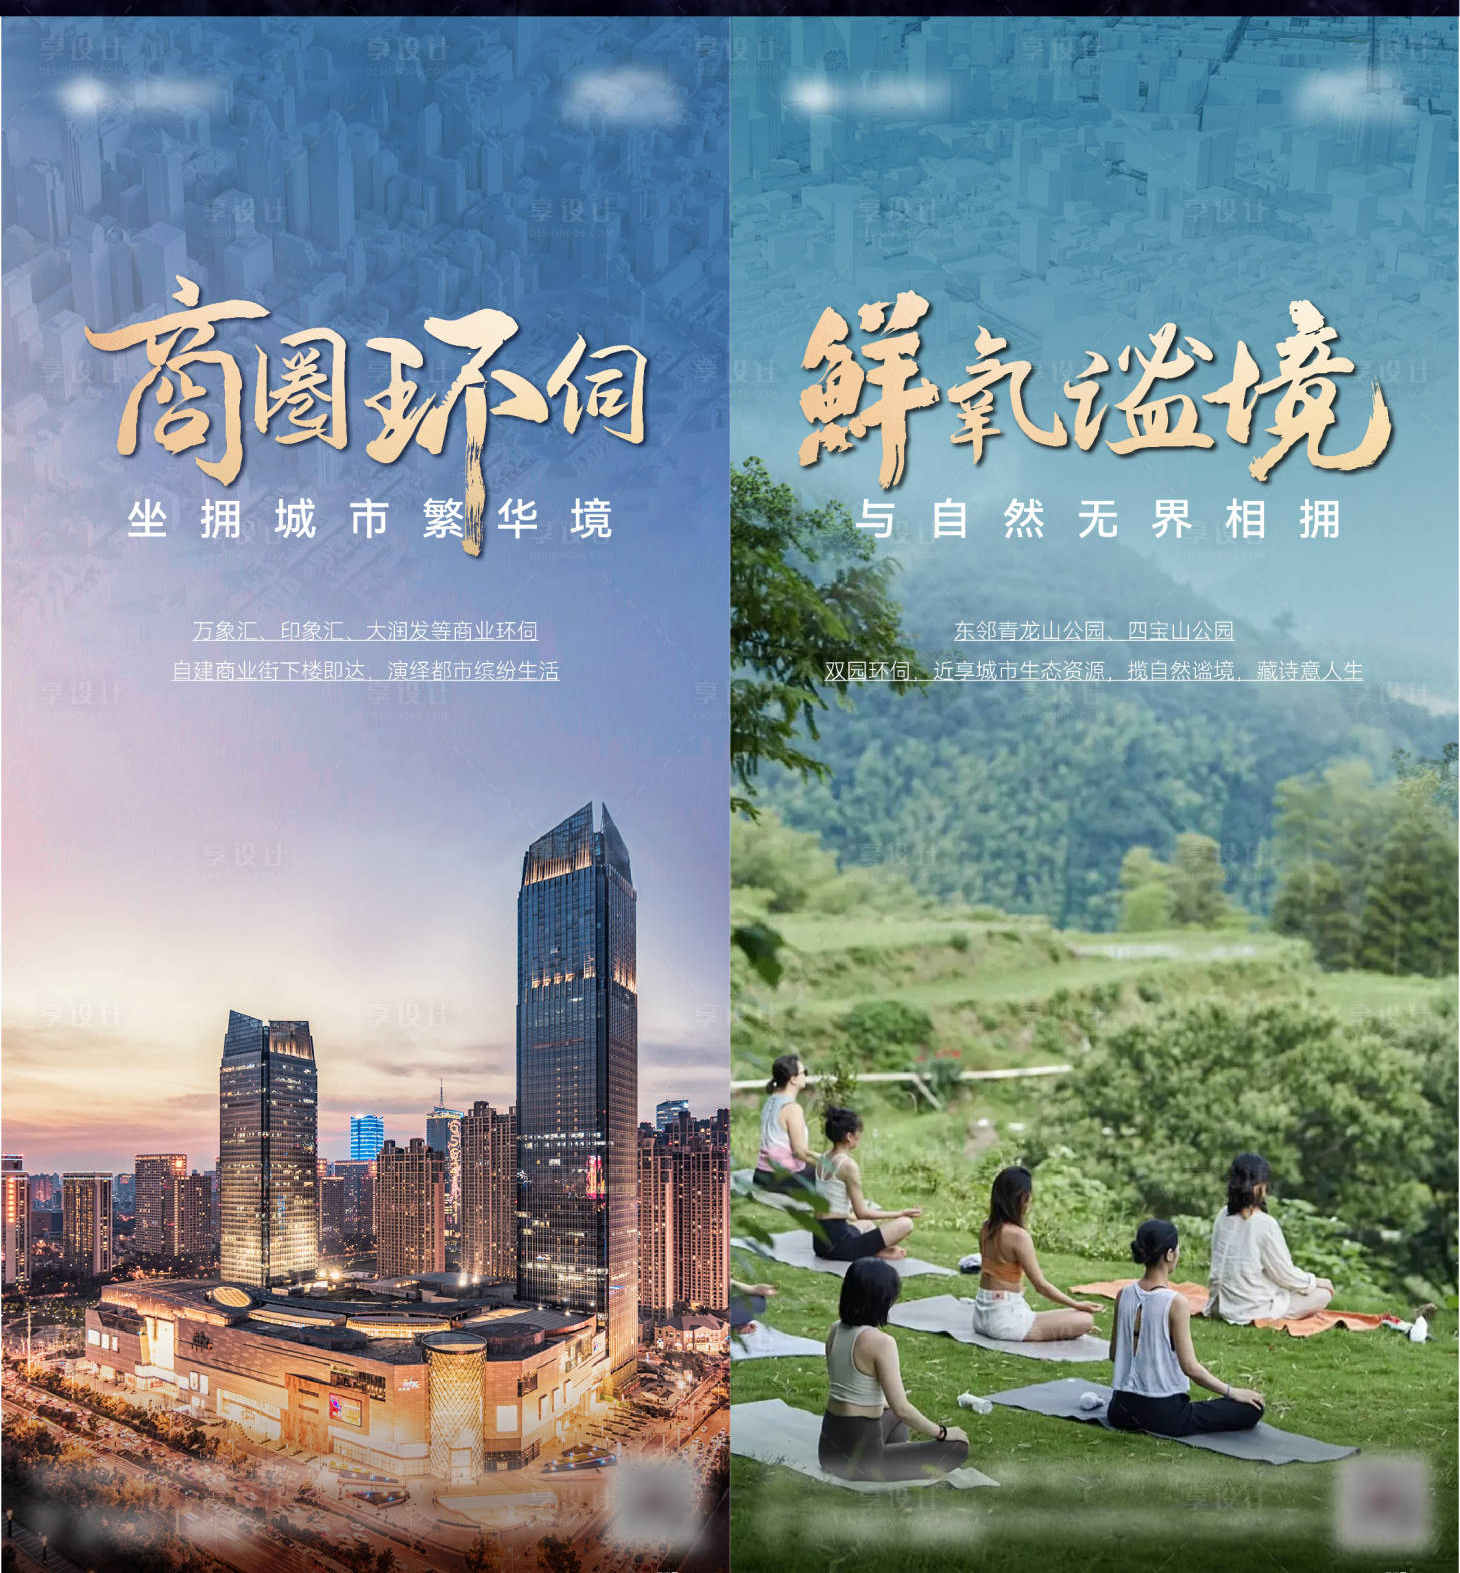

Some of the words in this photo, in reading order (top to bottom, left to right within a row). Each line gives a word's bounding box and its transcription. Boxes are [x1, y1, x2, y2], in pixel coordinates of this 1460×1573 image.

[798, 290, 1393, 489] 鲜氧谧境
[84, 275, 648, 557] 商圈环伺
[127, 498, 613, 540] 坐拥城市繁华境
[855, 498, 1341, 539] 与自然无界相拥
[193, 620, 538, 642] 万象汇、印象汇、大润发等商业环伺
[954, 619, 1235, 642] 东邻青龙山公园、四宝山公园
